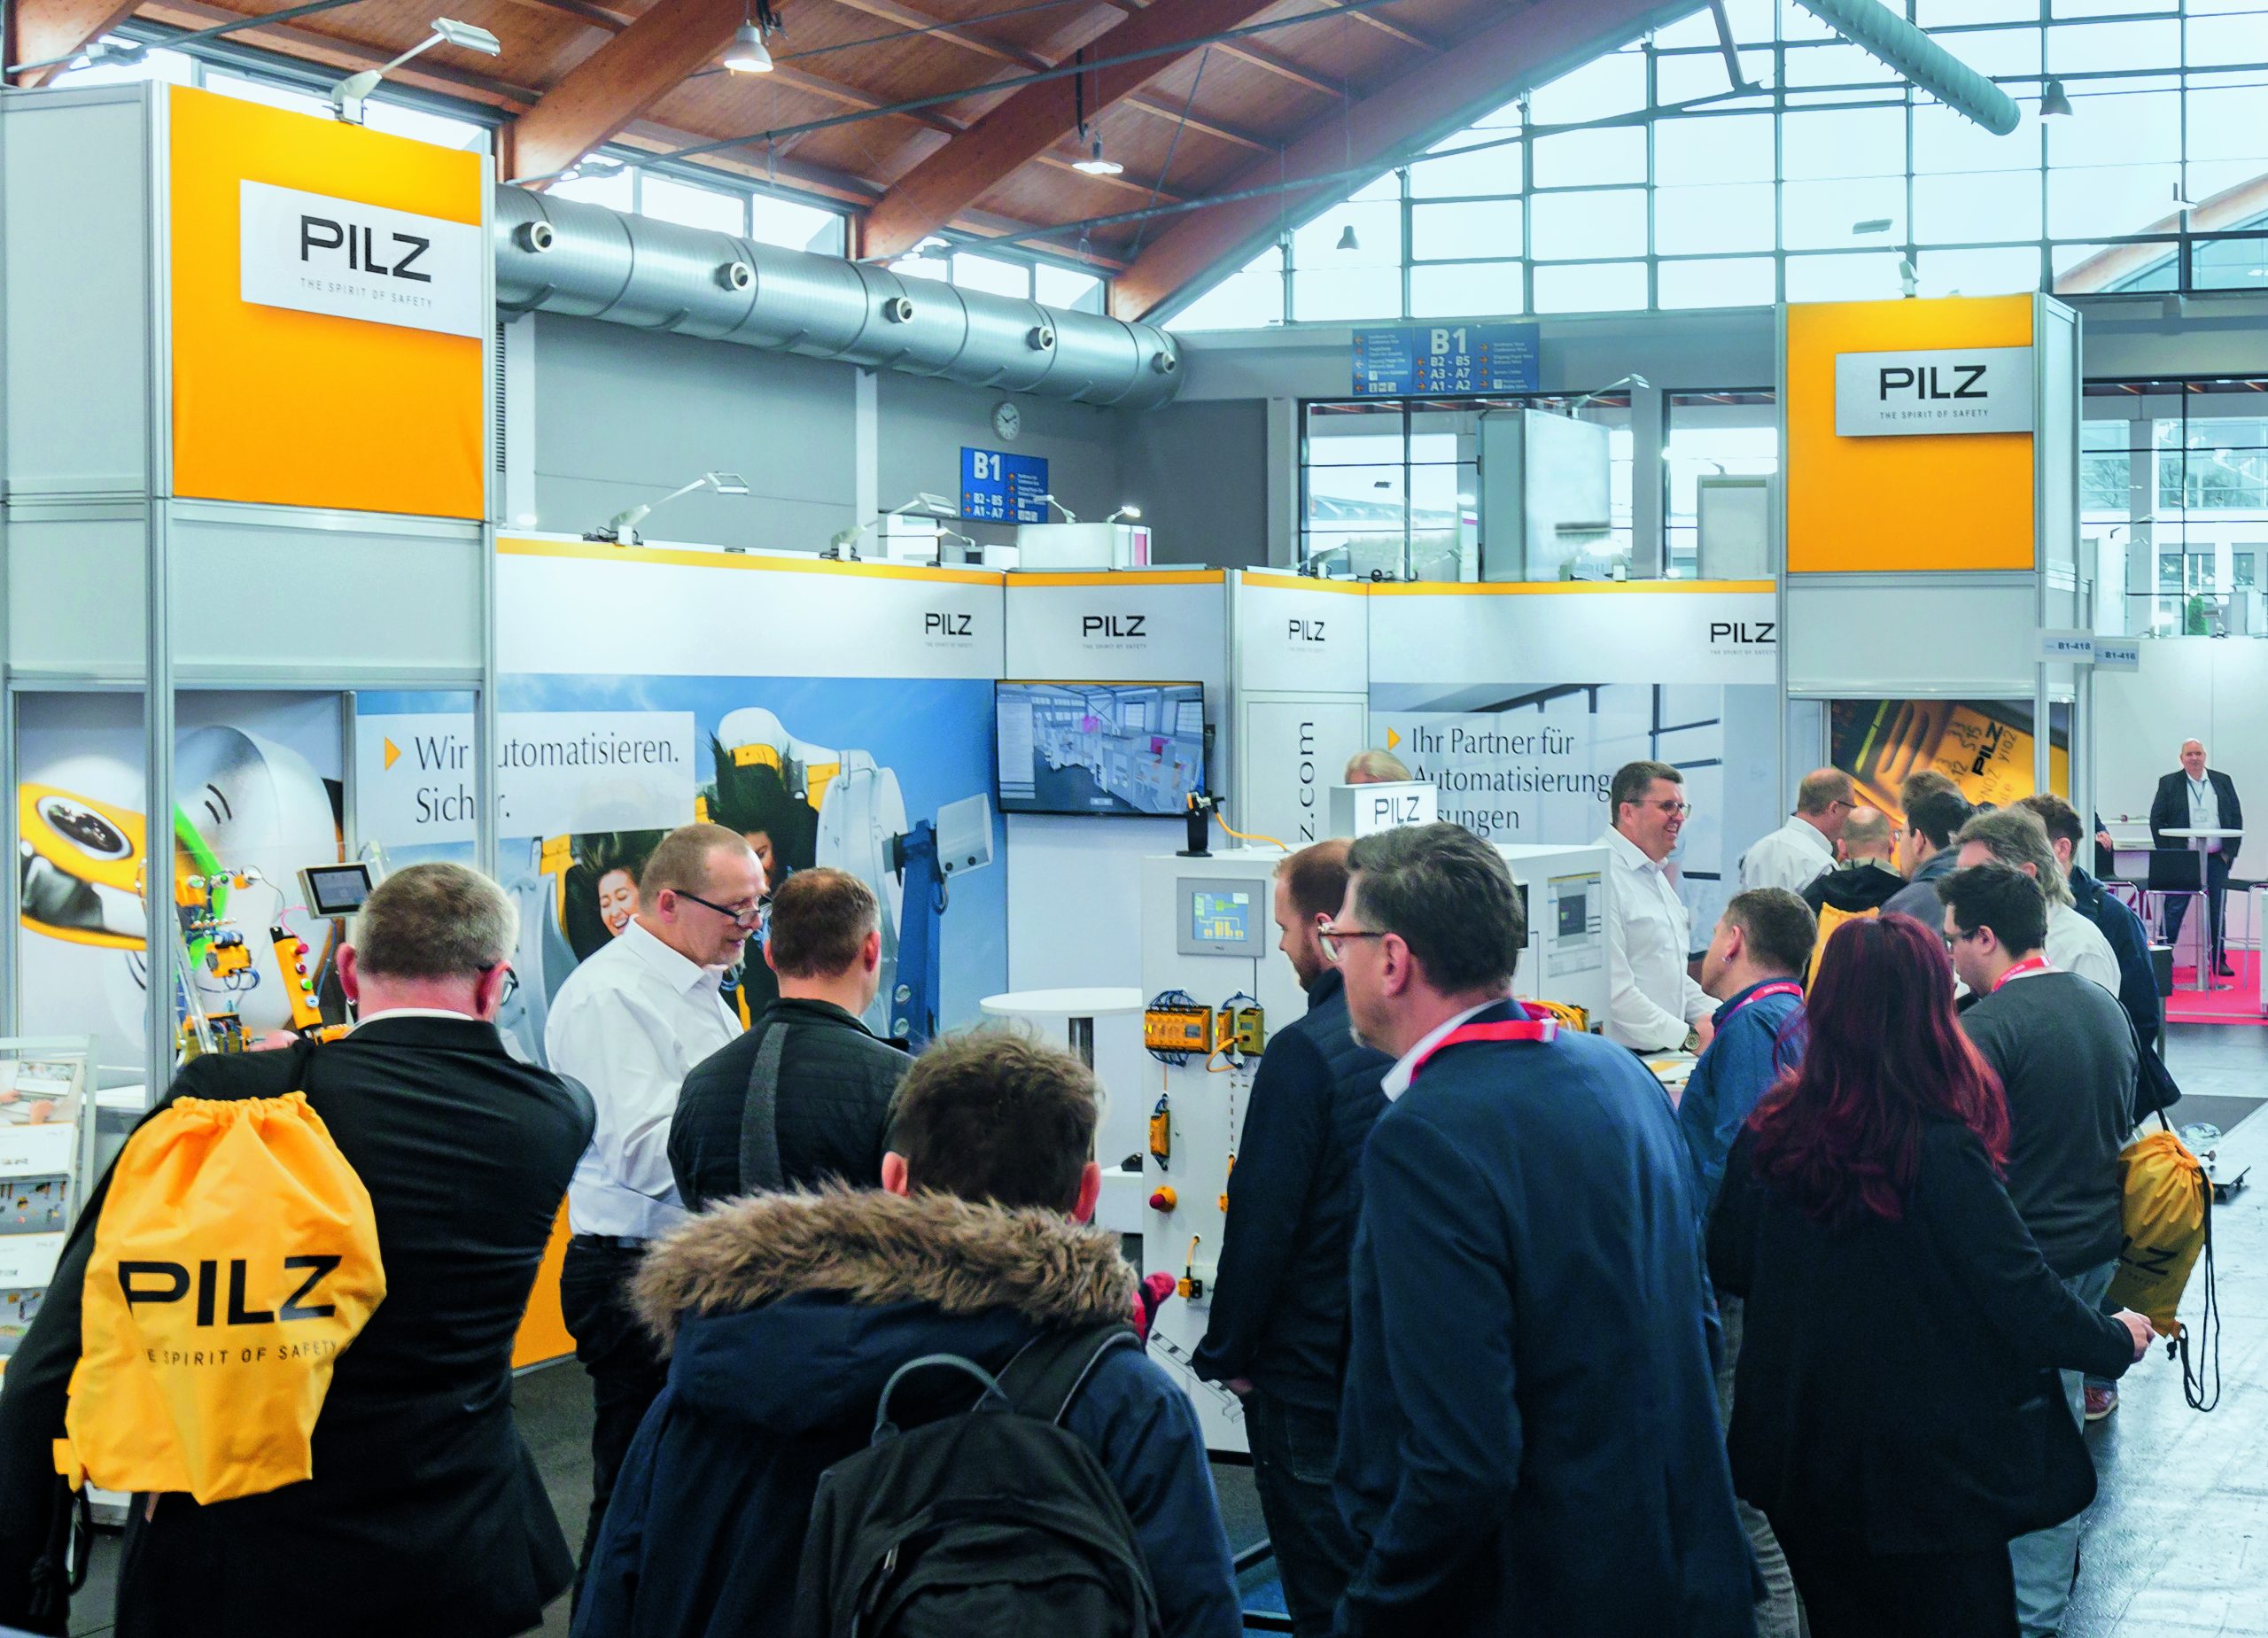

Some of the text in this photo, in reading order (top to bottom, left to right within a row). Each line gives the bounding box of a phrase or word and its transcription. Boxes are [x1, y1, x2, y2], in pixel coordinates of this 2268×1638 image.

[301, 215, 431, 283] PILZ
[301, 277, 432, 307] THE SPIRIT OF SAFETY
[1431, 328, 1466, 354] B1
[1430, 356, 1445, 367] B2
[1456, 355, 1471, 366] B5
[1430, 369, 1446, 379] A3
[1455, 368, 1471, 378] A7
[1430, 381, 1445, 392] A1
[1456, 380, 1471, 391] A2
[1880, 365, 1987, 400] PILZ
[1901, 410, 1932, 419] SPIRIT
[1953, 409, 1988, 418] SAFETY
[974, 451, 1000, 482] B1
[926, 613, 972, 636] PILZ
[1083, 616, 1146, 637] PILZ
[1289, 620, 1324, 641] PILZ
[1711, 623, 1776, 643] PILZ
[415, 732, 679, 770] Wir utomatisieren.
[1413, 726, 1574, 755] Ihr Partner für
[1971, 721, 2003, 776] PILZ
[1299, 722, 1315, 842] z.com
[1414, 765, 1612, 803] Automatisierung
[416, 784, 510, 823] Sichr.
[1375, 796, 1419, 825] PILZ
[1437, 807, 1519, 838] sungen
[118, 1255, 343, 1327] PILZ
[163, 1350, 229, 1366] SPIRIT
[241, 1348, 267, 1362] OF
[277, 1339, 337, 1361] SAFETY
